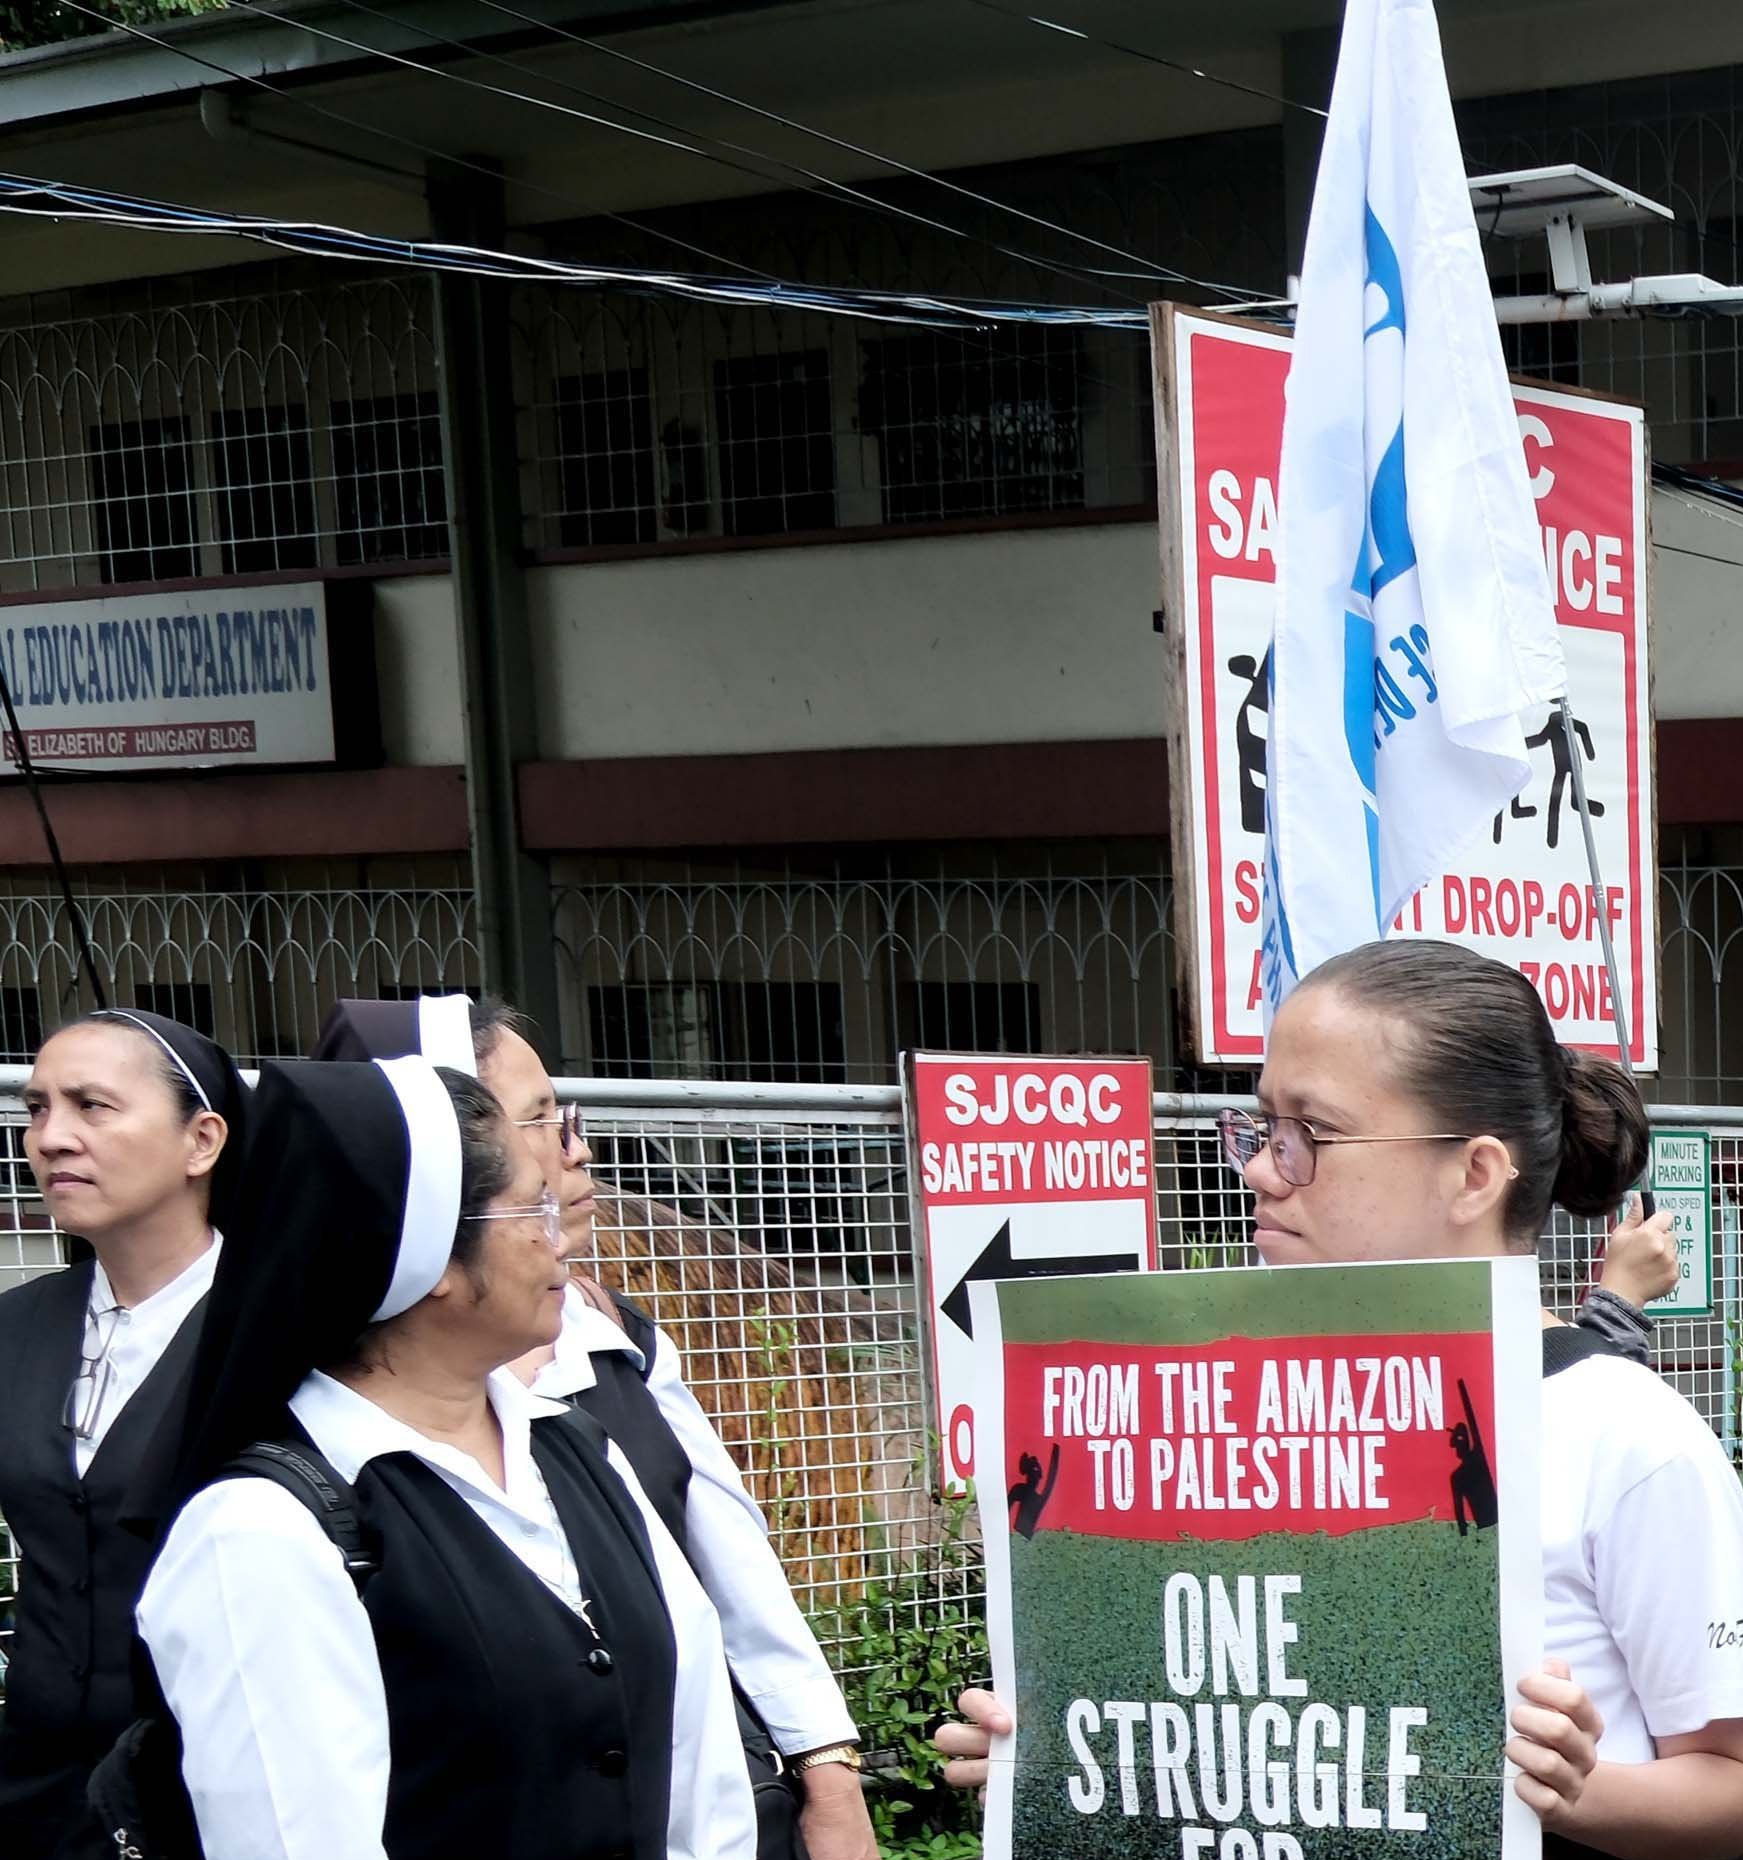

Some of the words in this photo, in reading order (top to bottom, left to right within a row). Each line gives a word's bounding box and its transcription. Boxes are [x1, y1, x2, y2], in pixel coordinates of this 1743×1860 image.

[24, 618, 156, 706] EDUCATION
[157, 607, 317, 698] DEPARTMENT
[28, 733, 104, 756] ELIZABETH
[107, 732, 126, 753] OF
[136, 729, 205, 751] HUNGARY
[209, 725, 254, 748] BLDG.
[1443, 873, 1624, 942] DROP-OFF
[944, 1073, 1122, 1128] SJCQC
[922, 1141, 1036, 1194] SAFETY
[1044, 1138, 1147, 1190] NOTICE
[1657, 1165, 1702, 1183] PARKING
[1660, 1143, 1699, 1161] MINUTE
[1659, 1197, 1677, 1209] AND
[1678, 1197, 1701, 1210] SPED
[1685, 1215, 1693, 1231] &
[1043, 1364, 1140, 1438] FROM
[1156, 1360, 1237, 1436] THE
[1255, 1355, 1446, 1435] AMAZON
[1087, 1438, 1136, 1512] TO
[1150, 1434, 1391, 1513] PALESTINE
[1164, 1572, 1308, 1700] ONE
[1066, 1700, 1429, 1832] STRUGGLE
